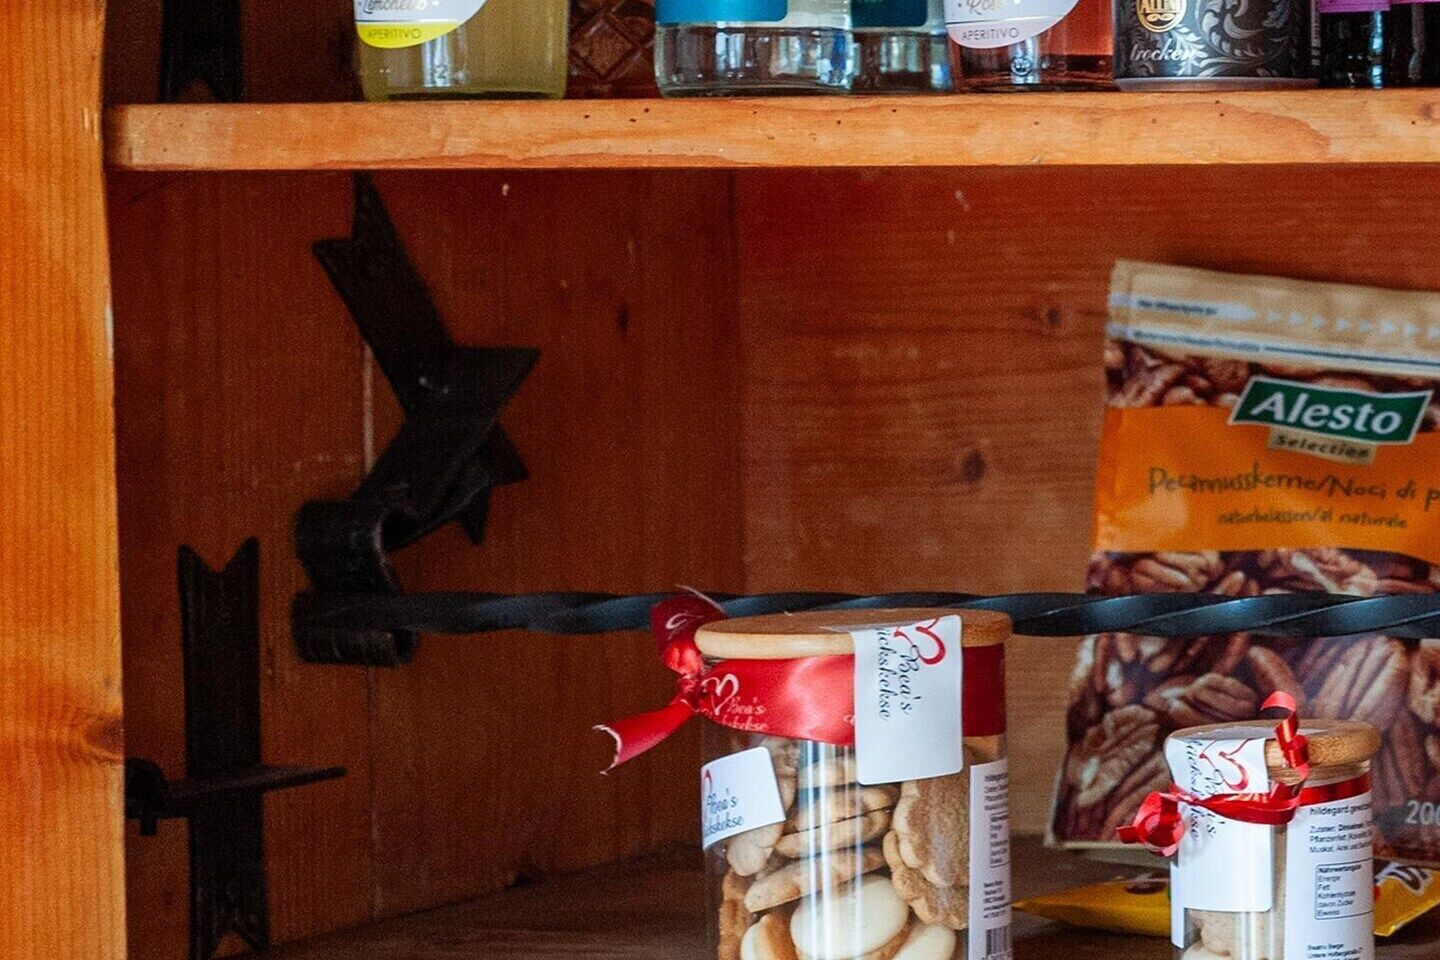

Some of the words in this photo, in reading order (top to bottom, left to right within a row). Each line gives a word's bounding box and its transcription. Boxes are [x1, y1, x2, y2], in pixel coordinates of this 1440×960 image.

[367, 28, 422, 40] APERITIVO
[962, 28, 1020, 40] APERITIVO
[1250, 391, 1402, 435] Alesto
[898, 644, 921, 715] Bea's
